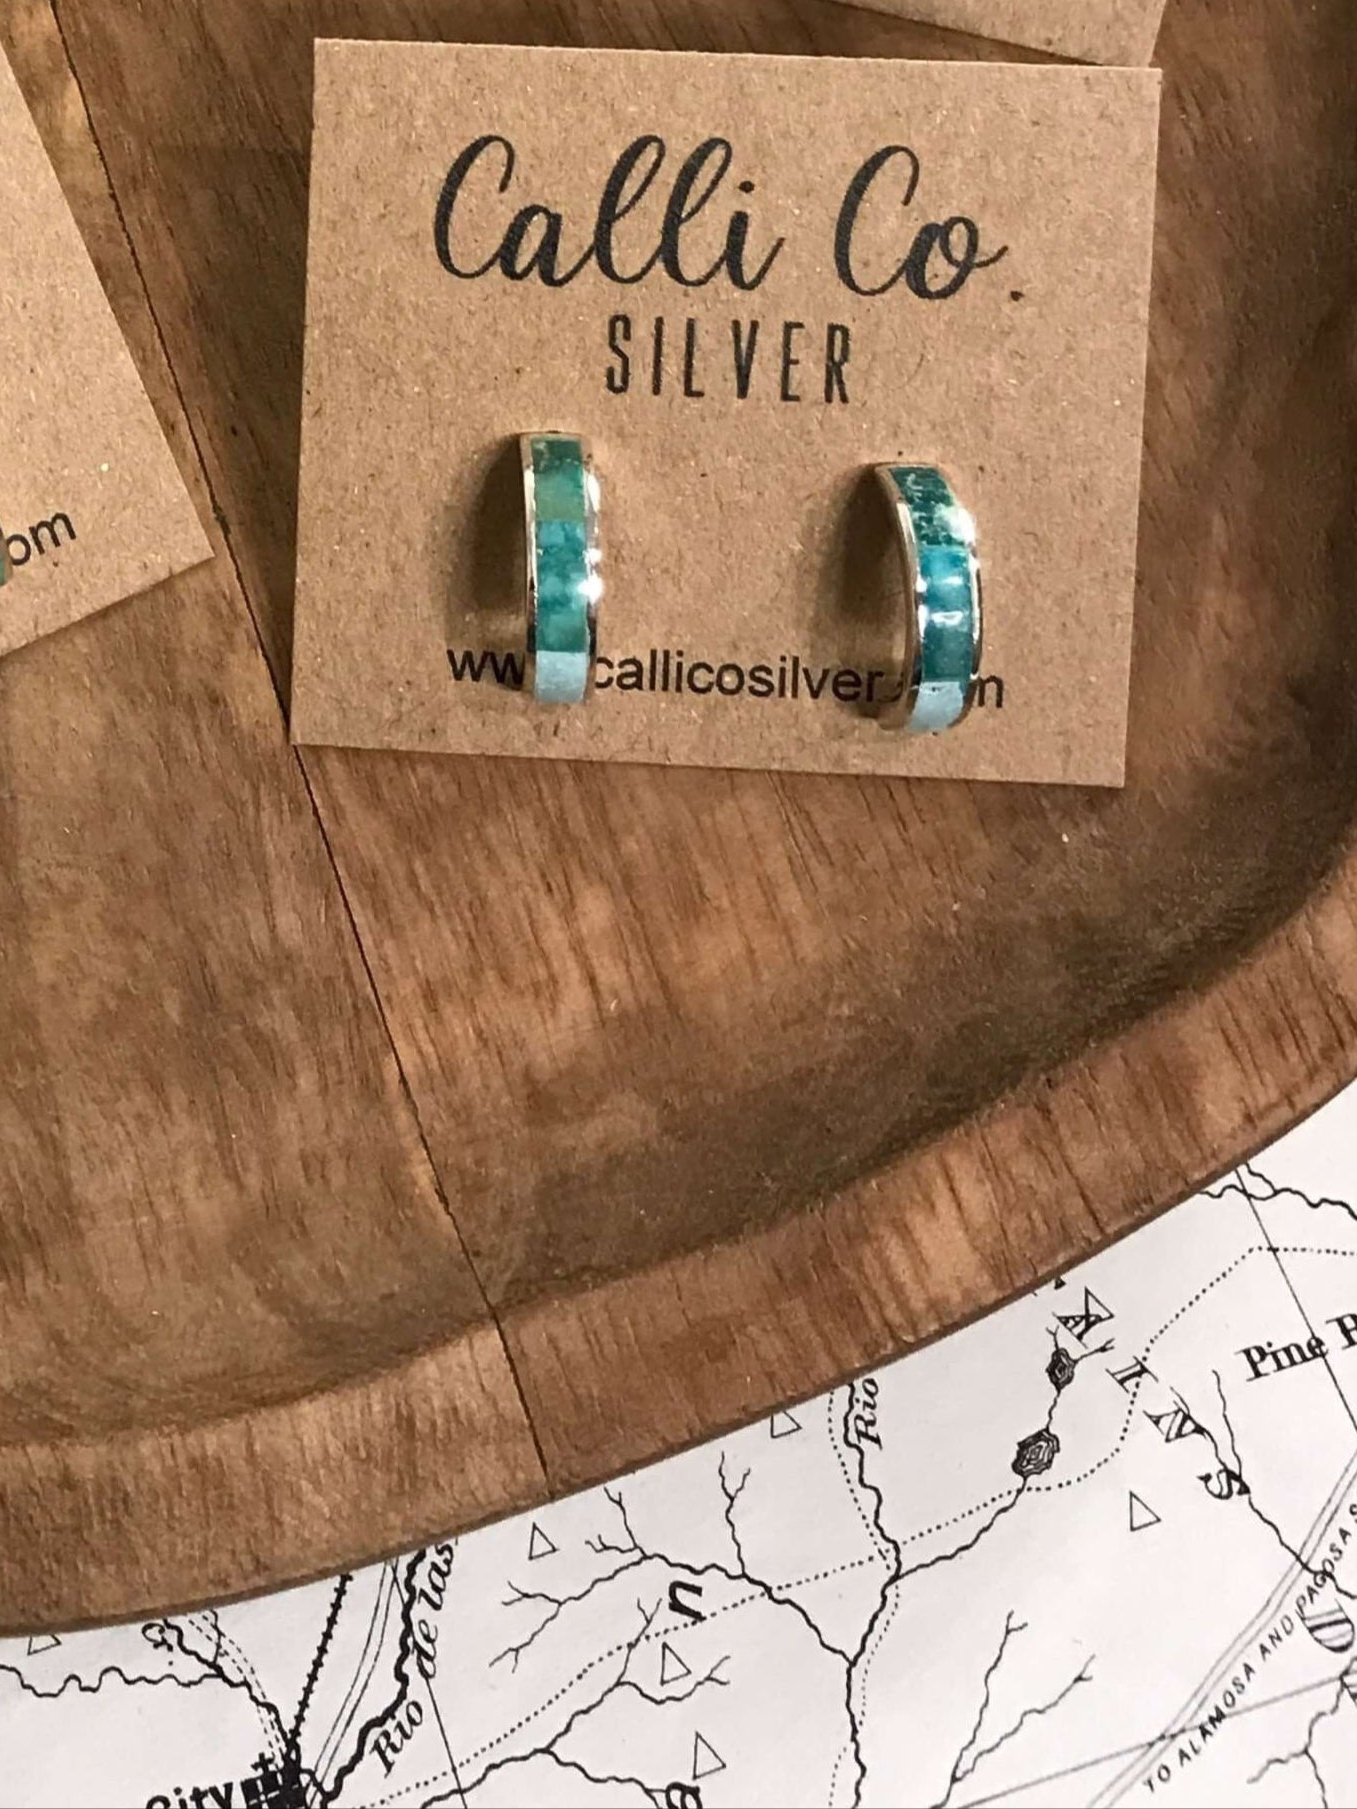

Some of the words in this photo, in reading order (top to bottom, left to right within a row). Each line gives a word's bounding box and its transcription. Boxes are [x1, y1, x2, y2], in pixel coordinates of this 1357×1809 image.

[433, 134, 786, 292] Calli
[834, 145, 1024, 302] Co.
[605, 313, 851, 404] SILVER
[853, 1377, 883, 1452] Rio
[1234, 1336, 1329, 1382] Pine
[369, 1699, 424, 1779] Rio
[415, 1618, 438, 1681] de
[1142, 1763, 1172, 1794] TO
[1177, 1661, 1257, 1768] ALAMOSA
[1258, 1613, 1295, 1664] AND
[1295, 1526, 1352, 1618] PAGOSA
